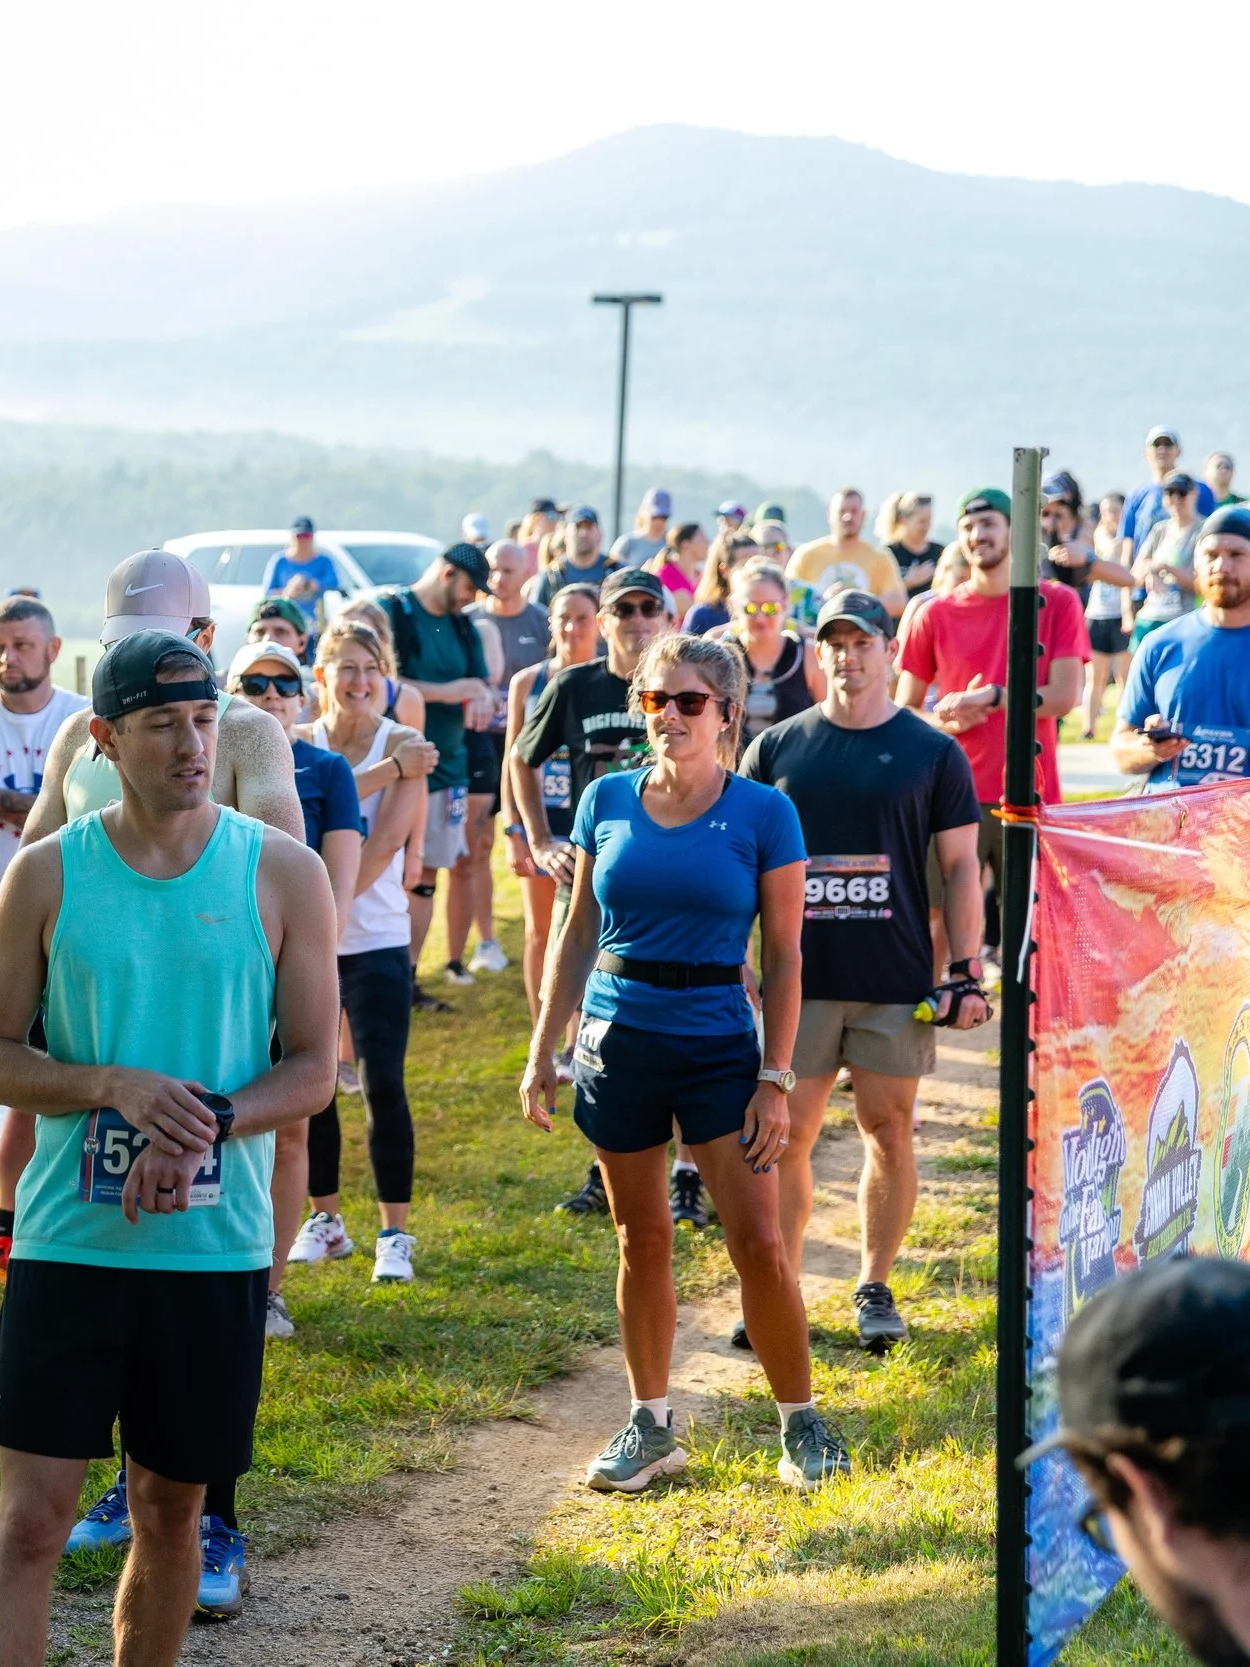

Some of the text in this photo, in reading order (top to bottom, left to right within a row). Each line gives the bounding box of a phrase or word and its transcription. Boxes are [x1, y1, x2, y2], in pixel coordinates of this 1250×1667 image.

[121, 690, 148, 705] DRI-FIT
[1181, 743, 1247, 774] 5312
[805, 877, 889, 903] 9668
[1172, 1152, 1198, 1213] VALLEY
